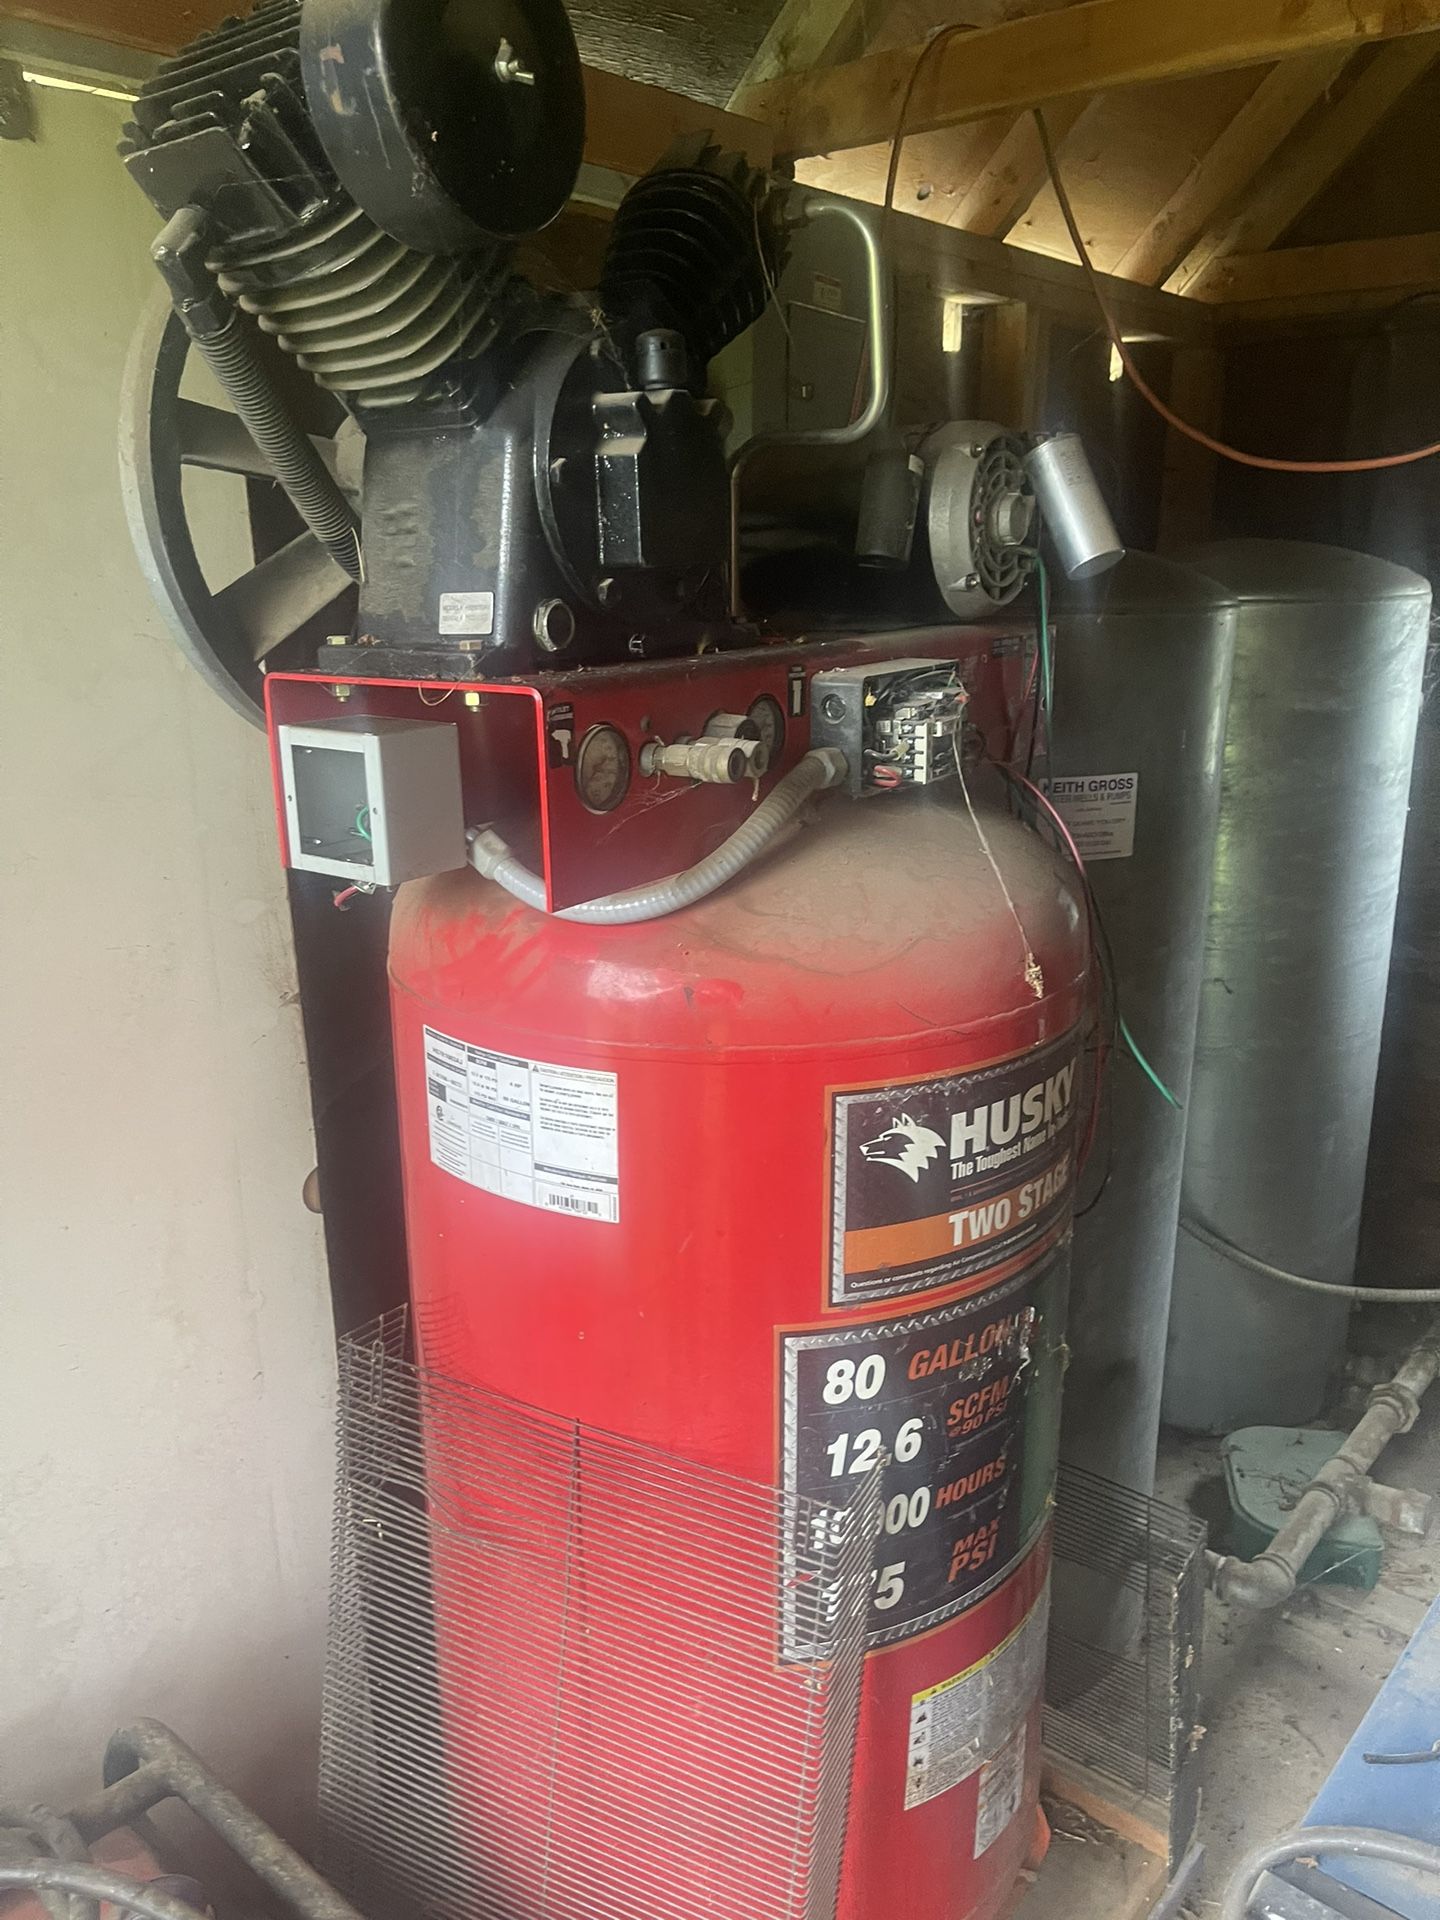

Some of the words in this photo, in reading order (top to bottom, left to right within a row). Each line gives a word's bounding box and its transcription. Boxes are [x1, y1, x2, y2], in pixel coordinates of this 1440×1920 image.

[1088, 777, 1134, 792] GROSS
[950, 1057, 1076, 1160] HUSKY
[951, 1162, 974, 1180] The
[975, 1142, 1022, 1173] Toughest
[949, 1198, 1011, 1247] TWO
[823, 1354, 886, 1405] 80
[947, 1376, 1009, 1426] SCFM
[935, 1456, 1006, 1509] HOURS
[948, 1533, 998, 1583] PSI
